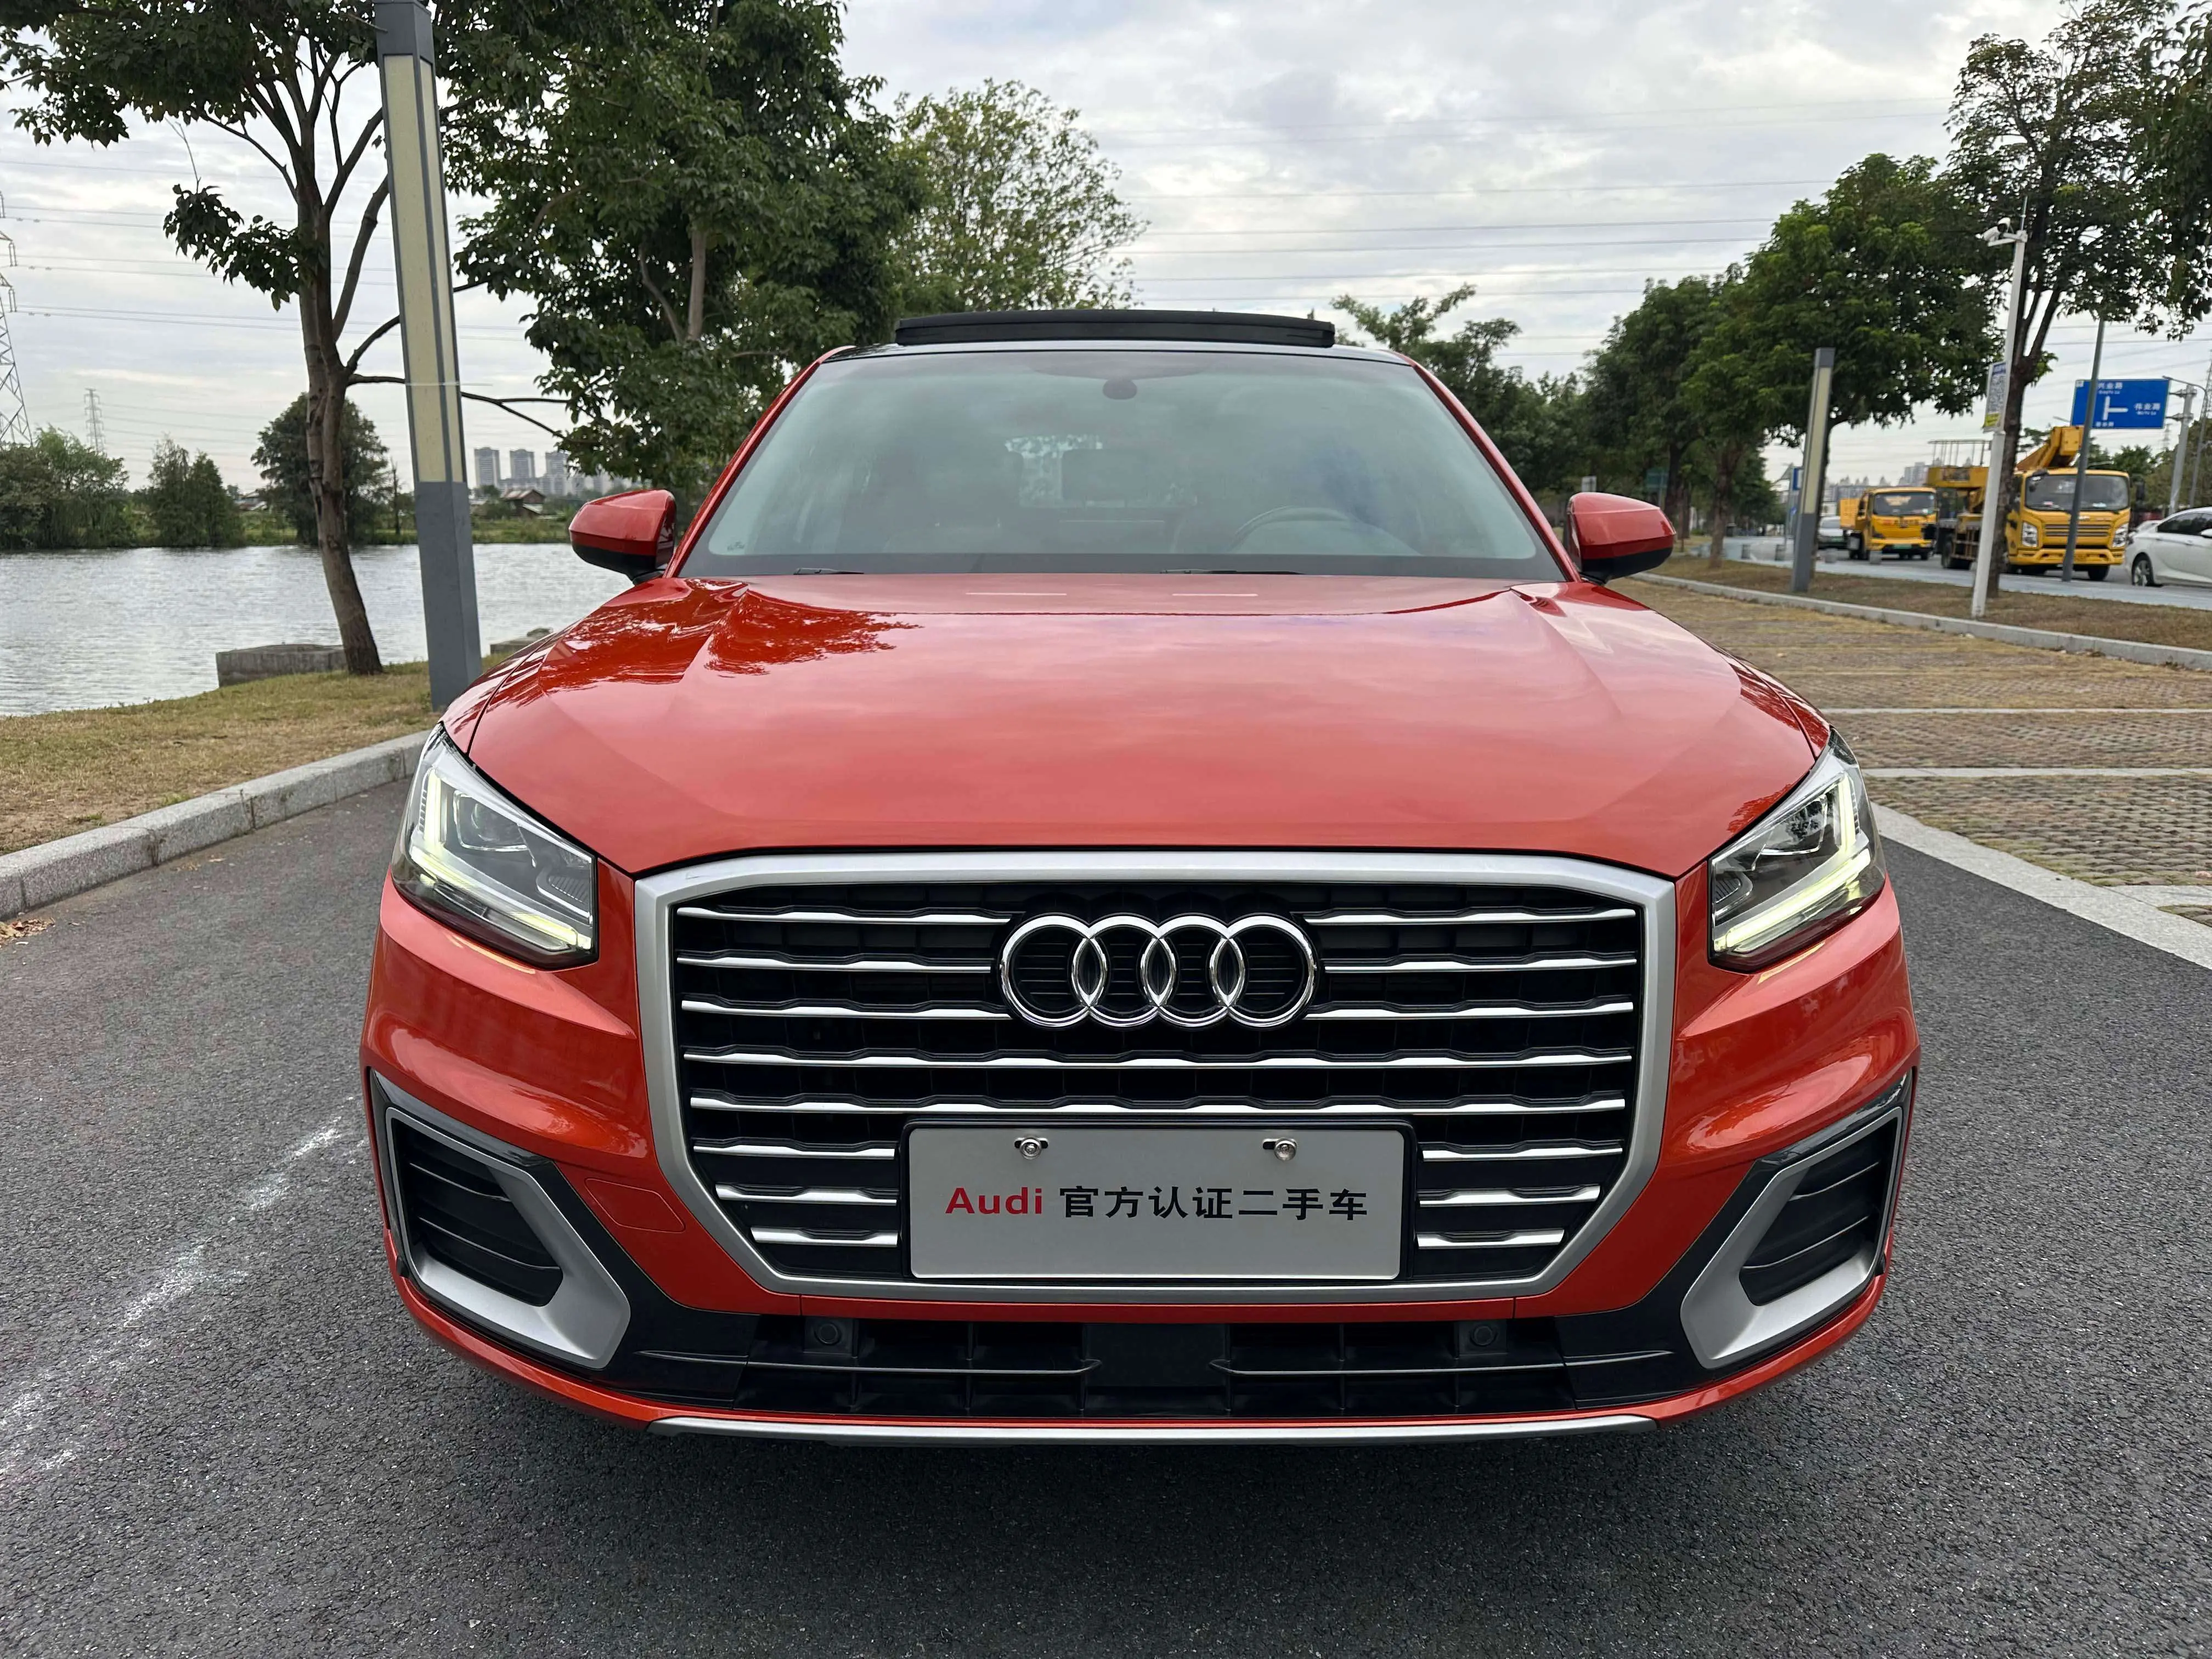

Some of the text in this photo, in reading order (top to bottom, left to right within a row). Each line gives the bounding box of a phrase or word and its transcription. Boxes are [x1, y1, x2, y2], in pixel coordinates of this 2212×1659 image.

[945, 1186, 1367, 1221] Audi 官方认证二手车
